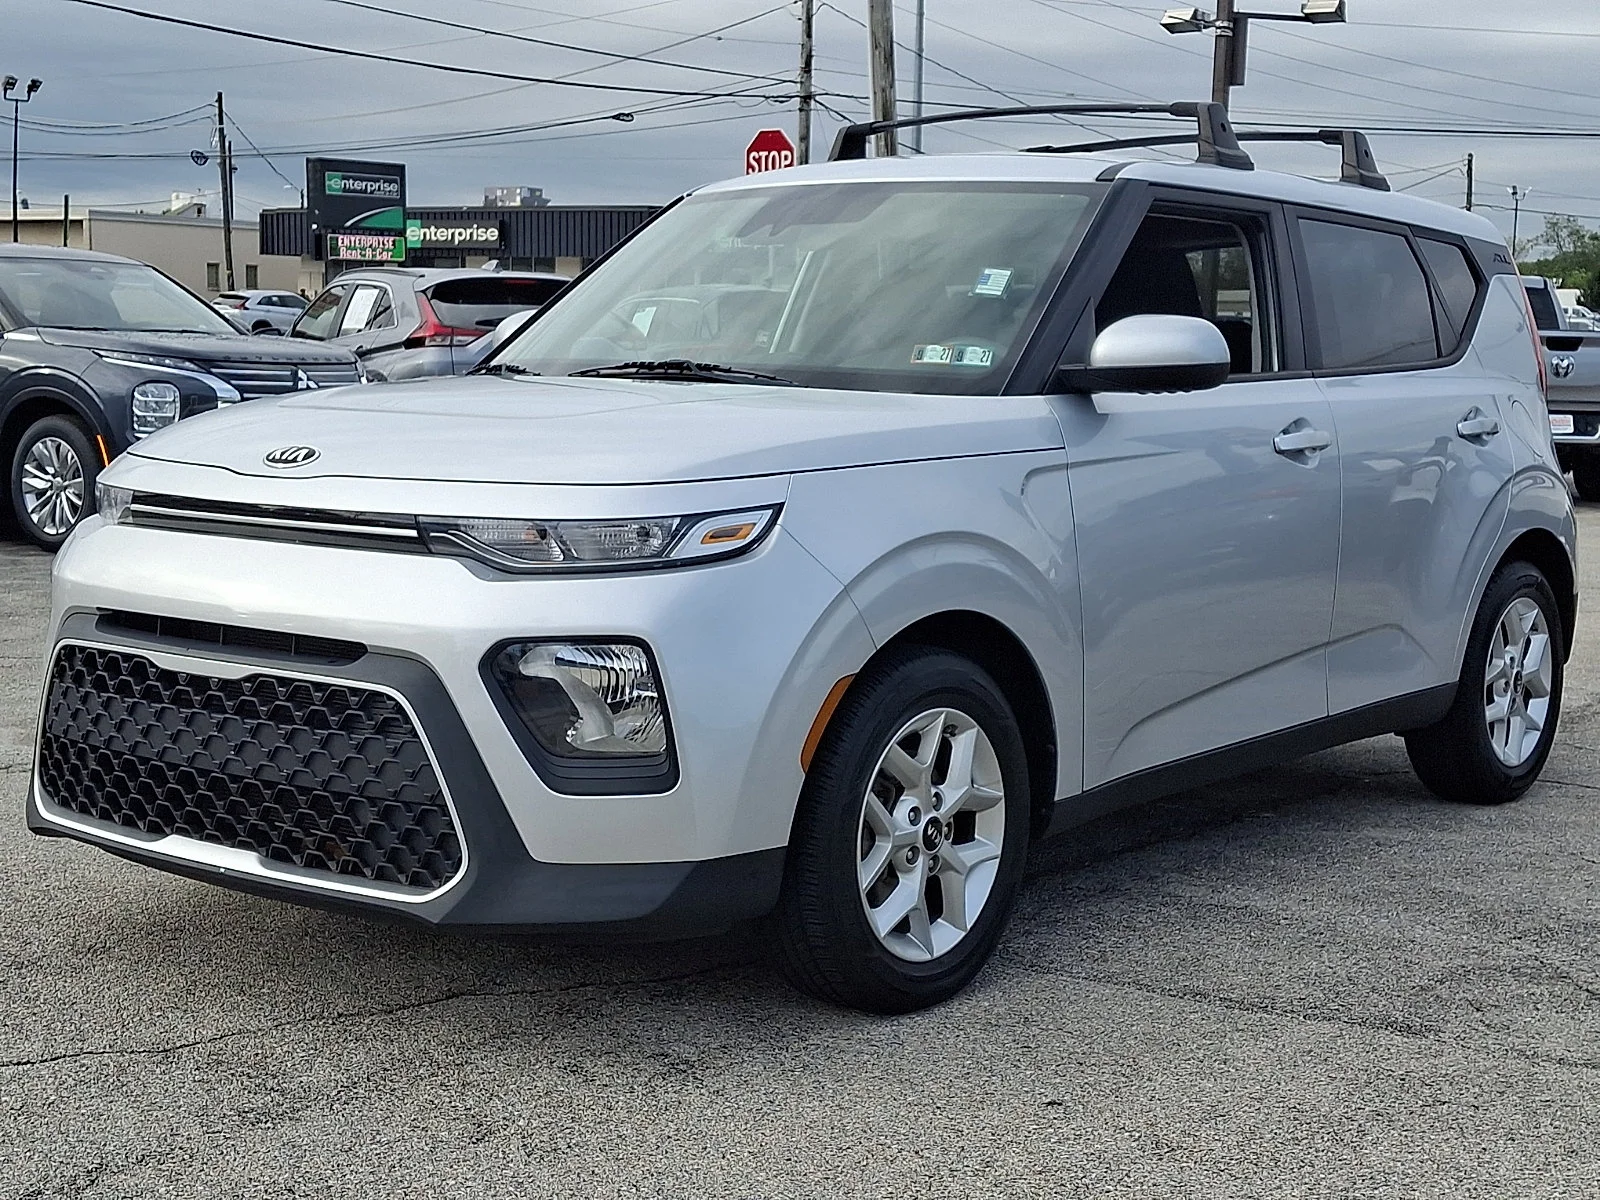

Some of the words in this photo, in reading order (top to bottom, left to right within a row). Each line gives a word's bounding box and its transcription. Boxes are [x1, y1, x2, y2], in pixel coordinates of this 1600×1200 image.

[748, 150, 792, 174] STOP
[331, 178, 398, 194] enterprise
[406, 223, 499, 245] enterprise
[338, 235, 395, 249] ENTERPRISE
[940, 348, 951, 362] 27
[980, 350, 991, 364] 27
[268, 447, 311, 462] KIA
